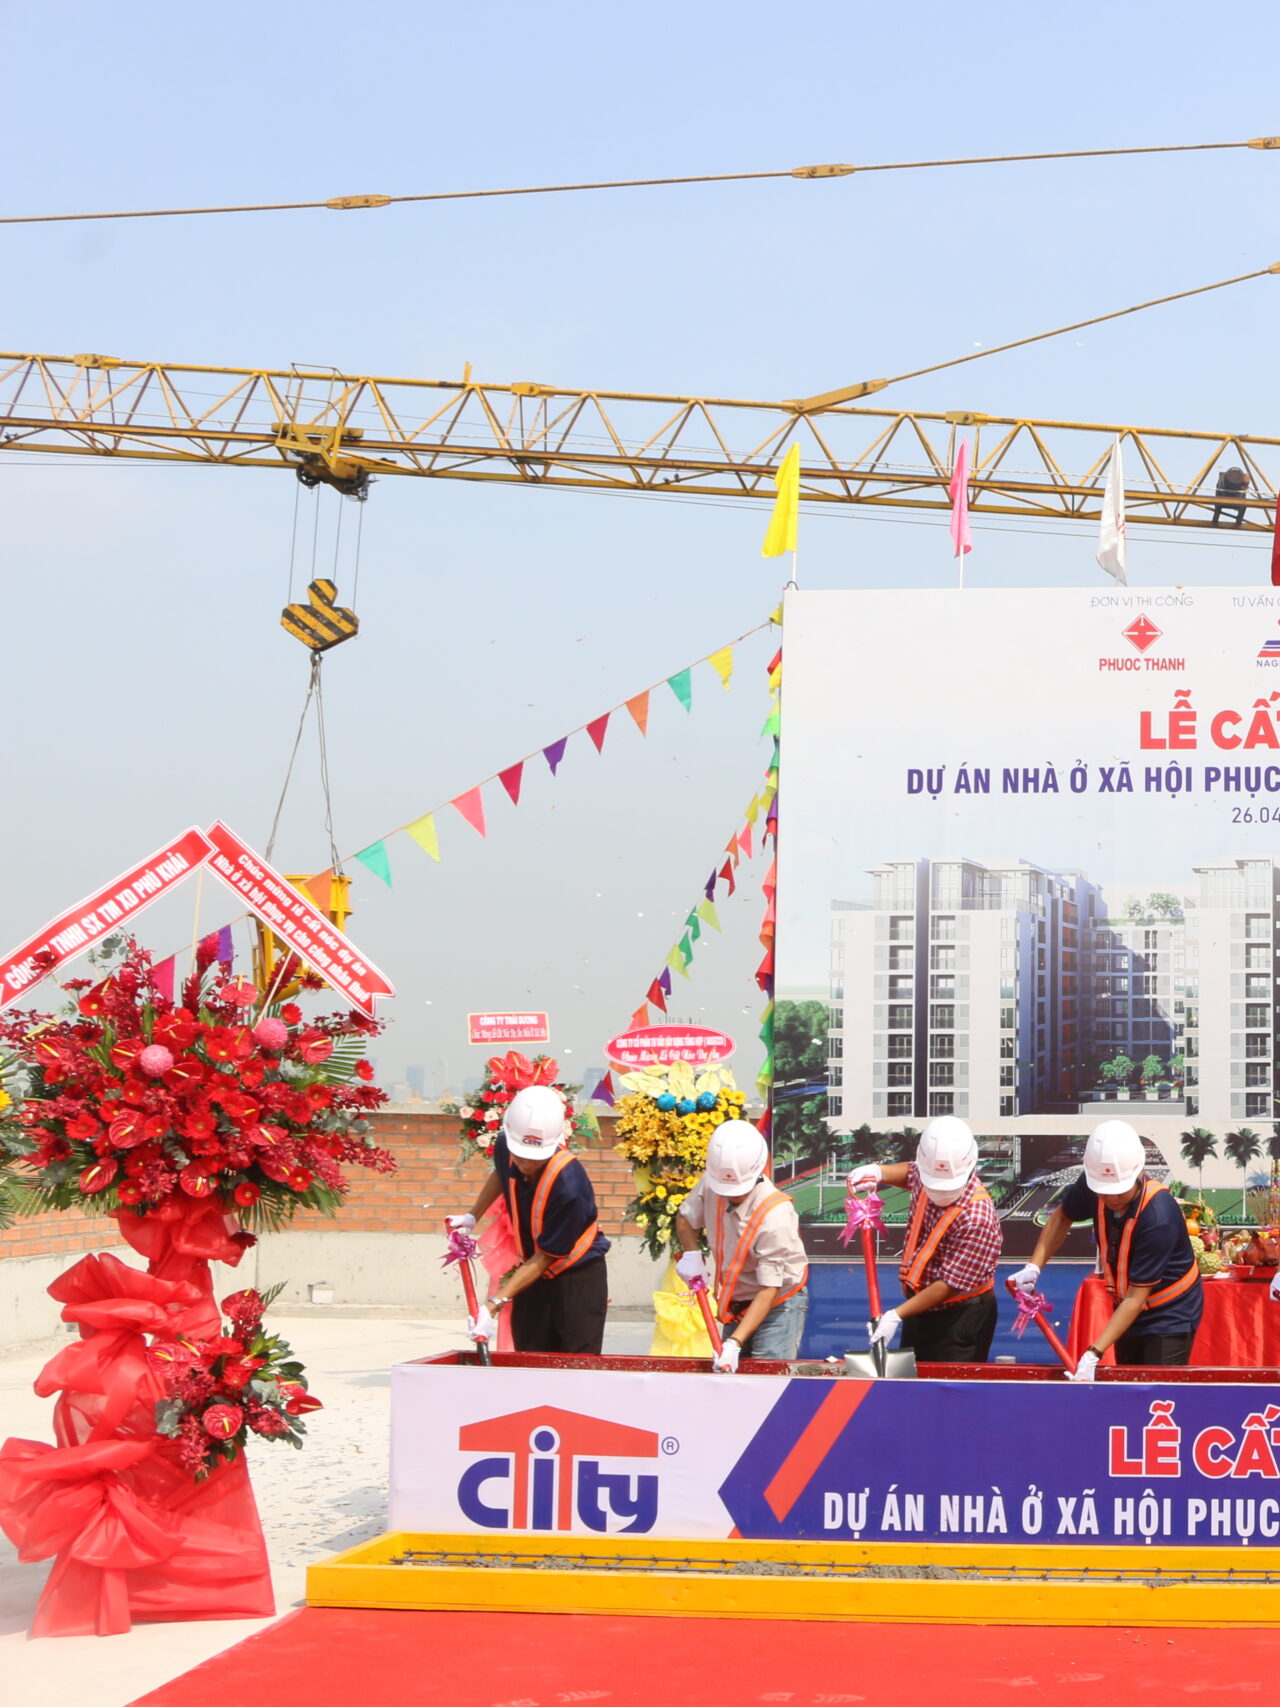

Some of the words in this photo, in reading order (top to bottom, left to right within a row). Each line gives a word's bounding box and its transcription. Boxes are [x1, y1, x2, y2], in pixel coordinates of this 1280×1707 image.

[1091, 596, 1119, 607] ĐƠN
[1122, 596, 1133, 609] VỊ
[1136, 596, 1152, 607] THI
[1155, 594, 1194, 607] CÔNG
[1232, 597, 1247, 607] TƯ
[1249, 594, 1274, 607] VẤN
[1099, 658, 1141, 671] PHUOC
[1144, 658, 1185, 671] THANH
[1140, 690, 1197, 750] LỄ
[907, 763, 945, 799] DỰ
[954, 764, 991, 793] ÁN
[1002, 764, 1060, 793] NHÀ
[1070, 759, 1088, 793] Ở
[1098, 762, 1134, 793] XÃ
[1145, 760, 1193, 798] HỘI
[49, 923, 89, 955] TNHH
[80, 912, 106, 936] SX
[97, 899, 123, 923] TM
[115, 888, 139, 911] XD
[213, 854, 235, 876] Nhà
[238, 876, 254, 893] xã
[248, 886, 267, 905] hội
[261, 899, 286, 924] phục
[281, 919, 297, 935] vụ
[294, 928, 311, 948] cho
[308, 944, 332, 968] công
[328, 962, 352, 987] nhân
[238, 854, 265, 881] Chúc
[263, 876, 293, 907] mừng
[291, 903, 305, 917] lễ
[302, 914, 319, 933] cất
[317, 929, 340, 951] nóc
[351, 960, 368, 977] án
[1109, 1400, 1181, 1478] LỄ
[824, 1487, 868, 1539] DỰ
[881, 1486, 929, 1533] ÁN
[940, 1486, 1008, 1533] NHÀ
[1021, 1484, 1045, 1535] Ở
[1057, 1488, 1100, 1535] XÃ
[1114, 1488, 1172, 1544] HỘI
[1188, 1498, 1280, 1545] PHỤC
